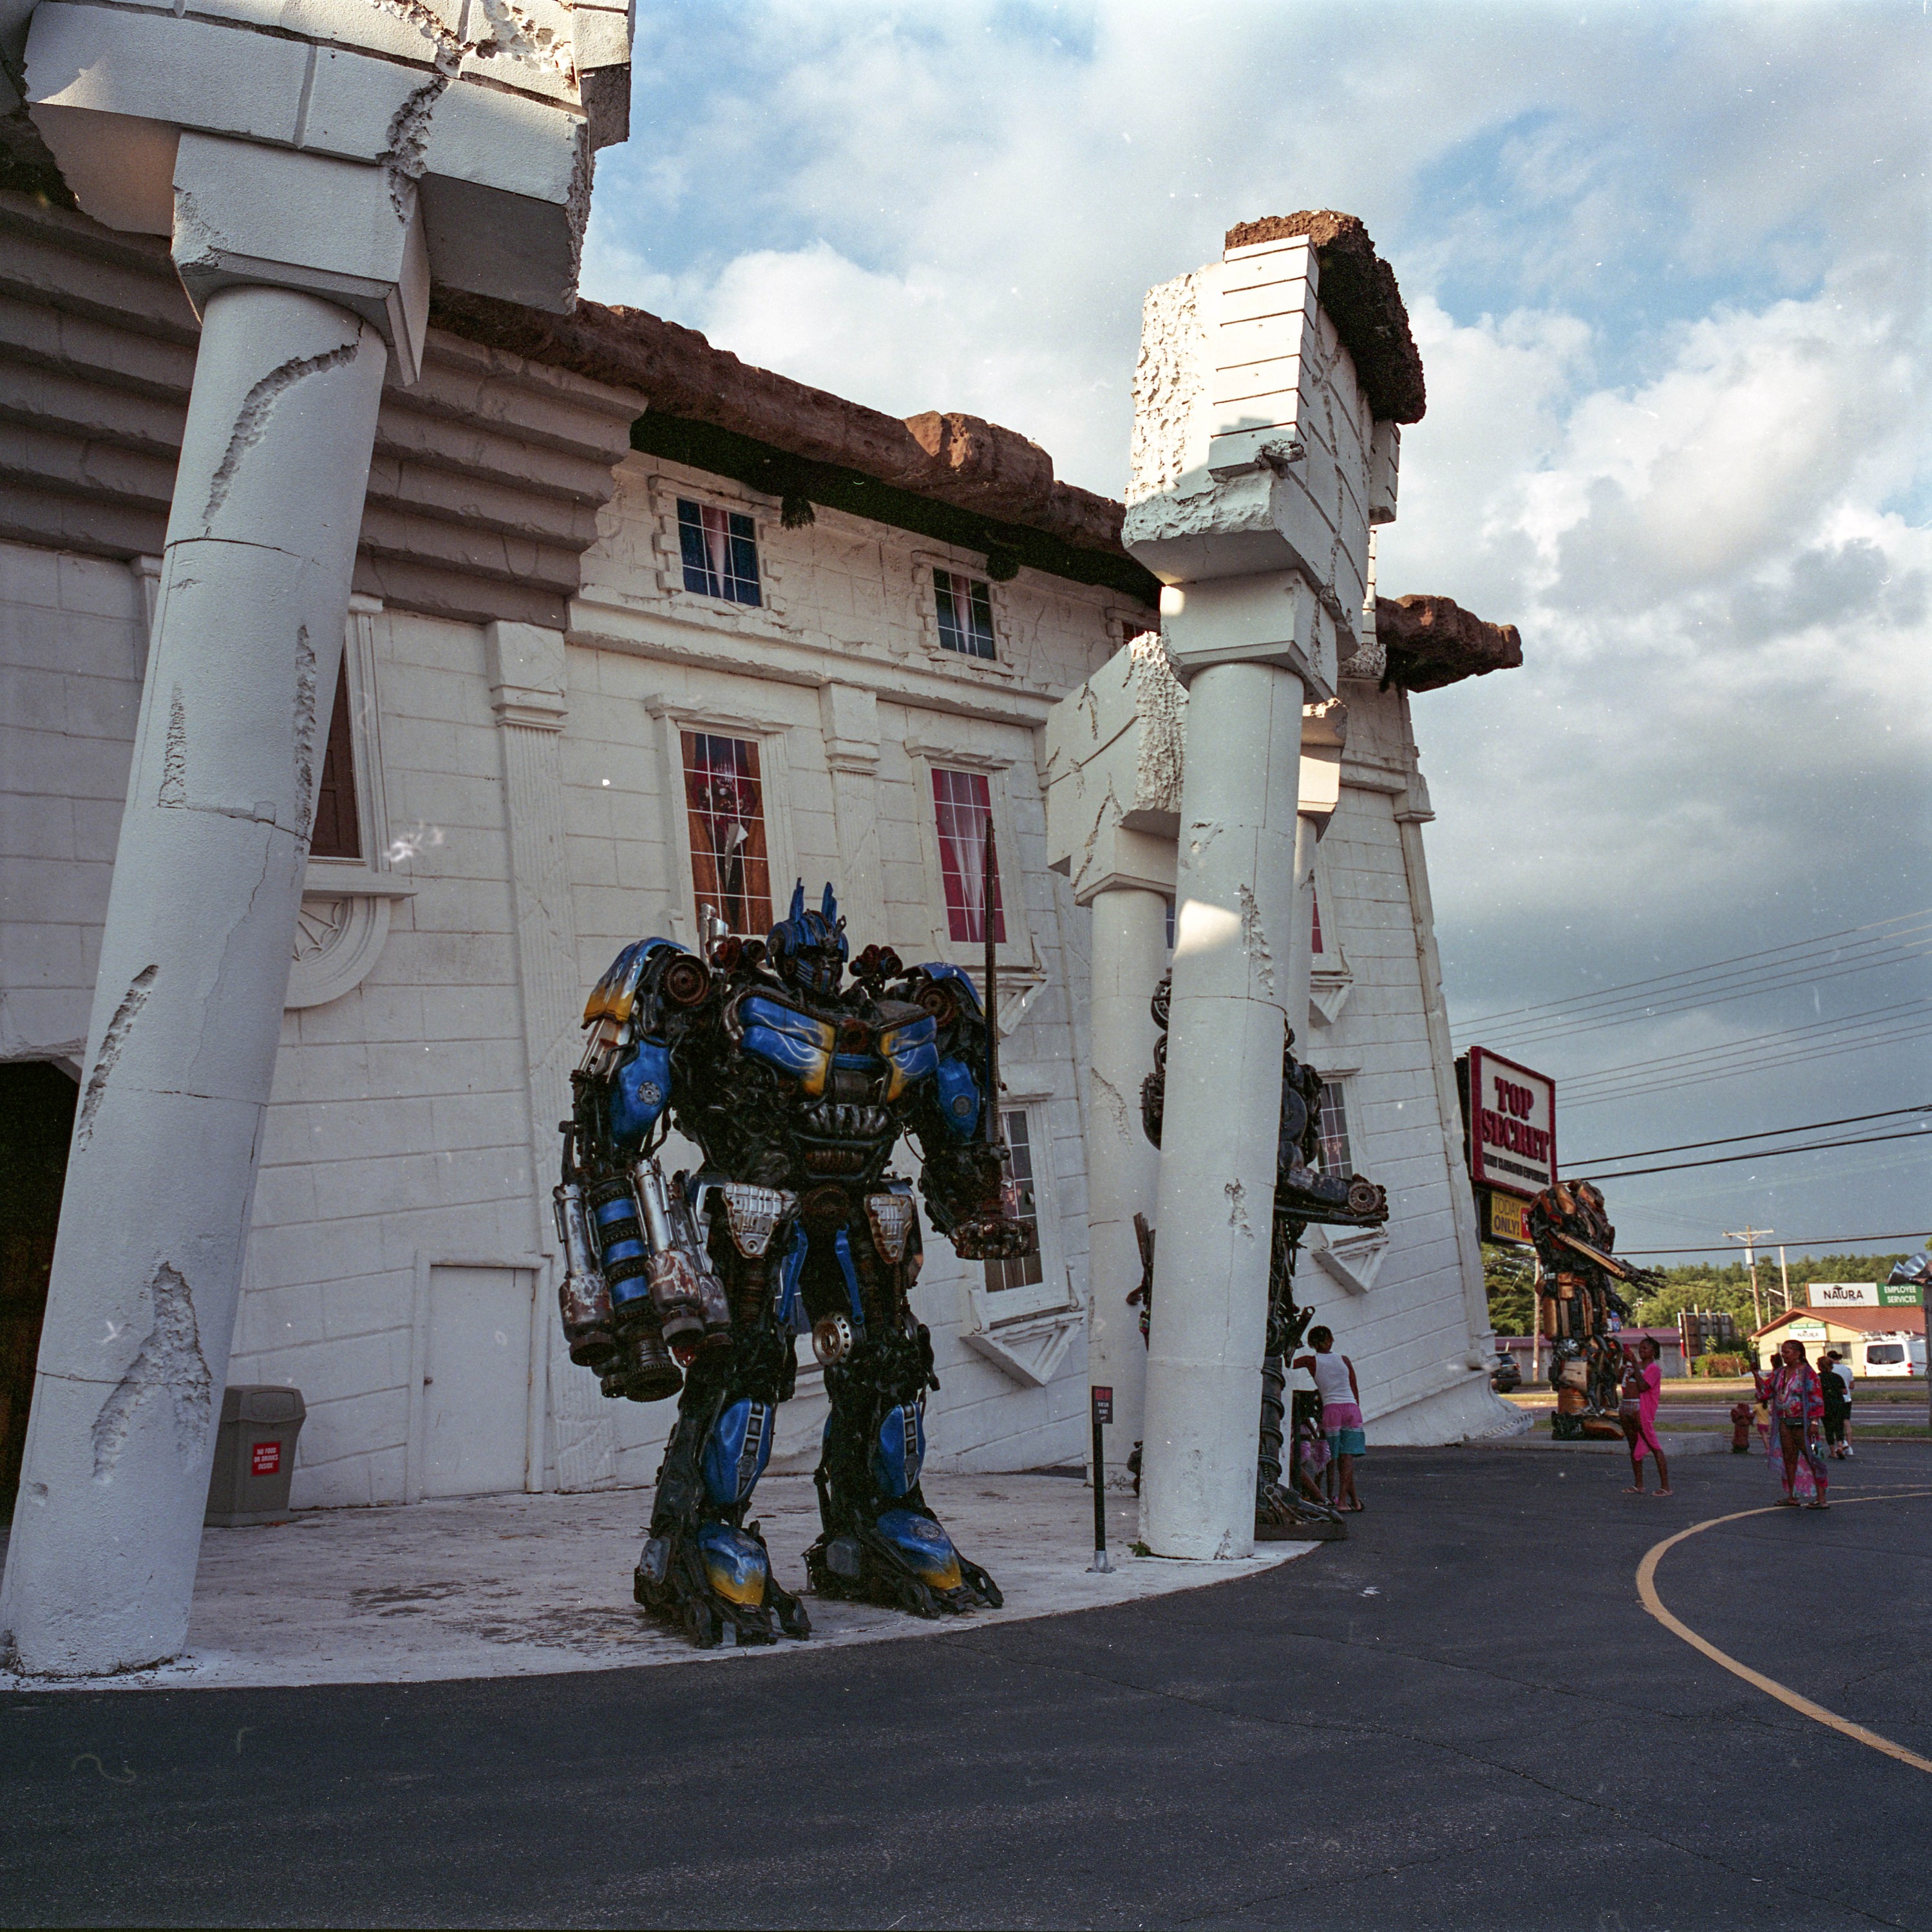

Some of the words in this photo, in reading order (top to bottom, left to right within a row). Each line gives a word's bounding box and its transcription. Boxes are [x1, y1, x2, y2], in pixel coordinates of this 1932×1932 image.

[1494, 1075, 1534, 1121] TOP
[1482, 1108, 1549, 1163] SECRET
[1493, 1195, 1520, 1219] TODAY
[1494, 1215, 1520, 1236] ONLY!
[1823, 1285, 1864, 1300] NATURA
[1884, 1285, 1917, 1294] EMPLOYEE
[1887, 1295, 1917, 1303] SERVICES
